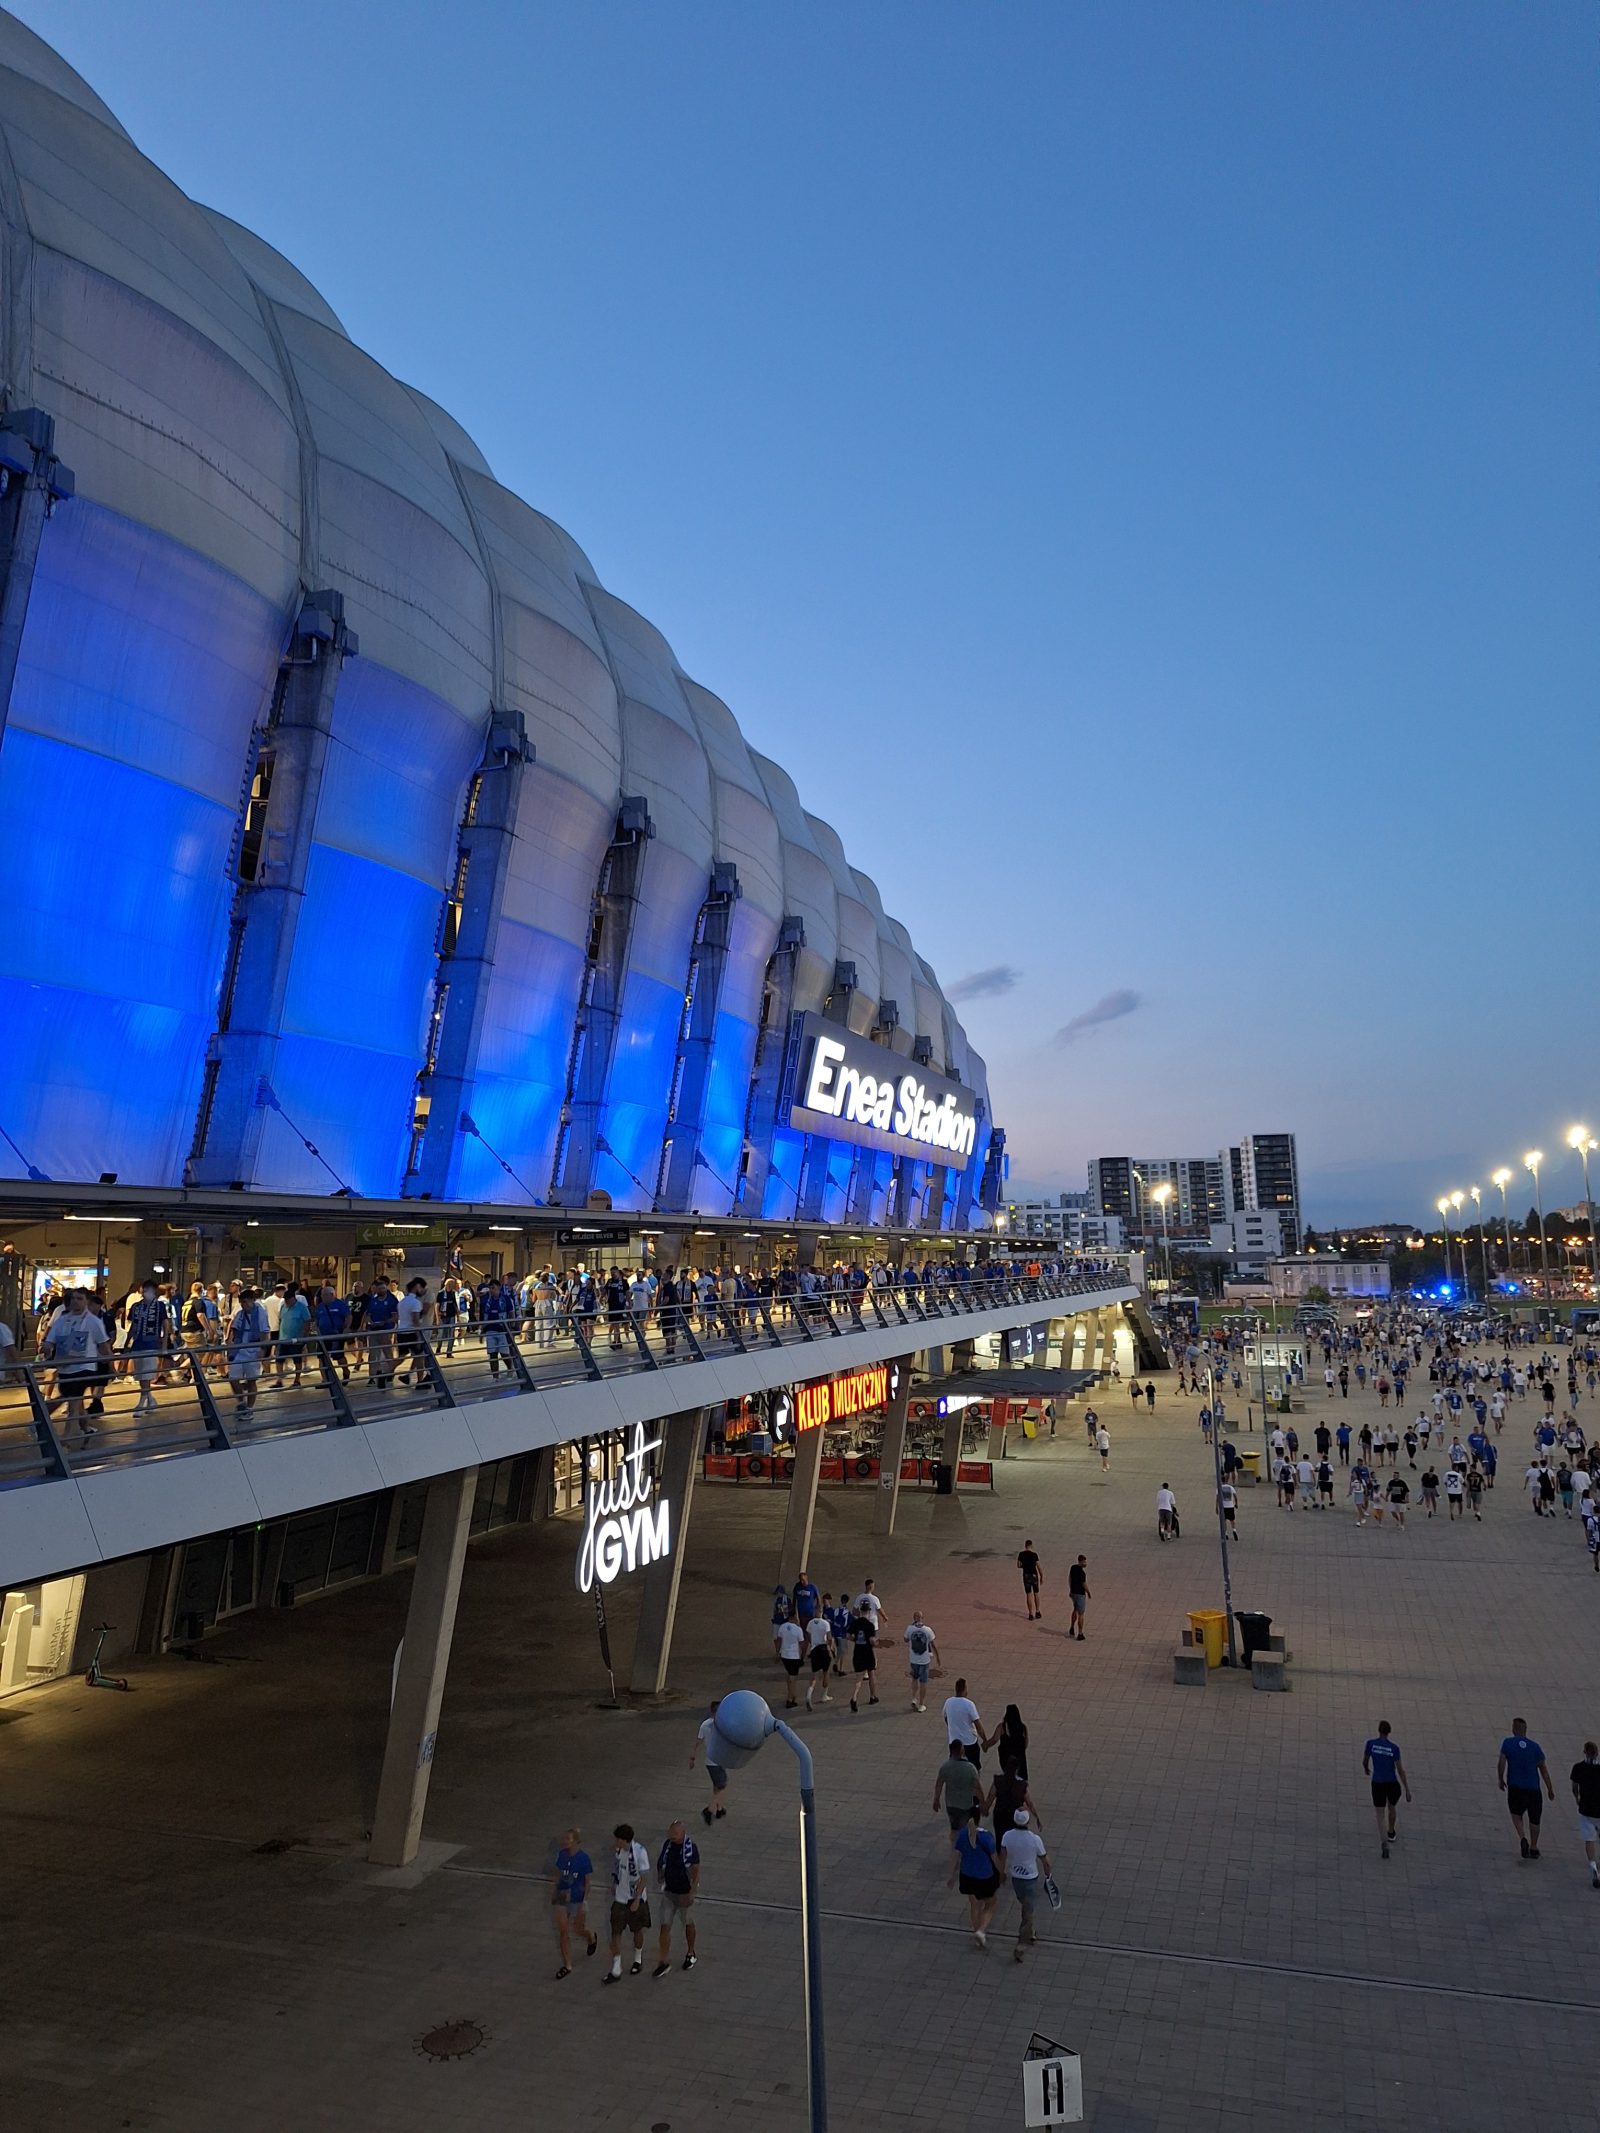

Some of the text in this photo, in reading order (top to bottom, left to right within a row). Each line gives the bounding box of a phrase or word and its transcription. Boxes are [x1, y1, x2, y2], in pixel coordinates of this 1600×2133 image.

[806, 1036, 976, 1156] Enea Stadion
[798, 1367, 887, 1432] KLUB MUZYCZNY
[580, 1421, 662, 1593] just
[595, 1499, 669, 1583] GYM
